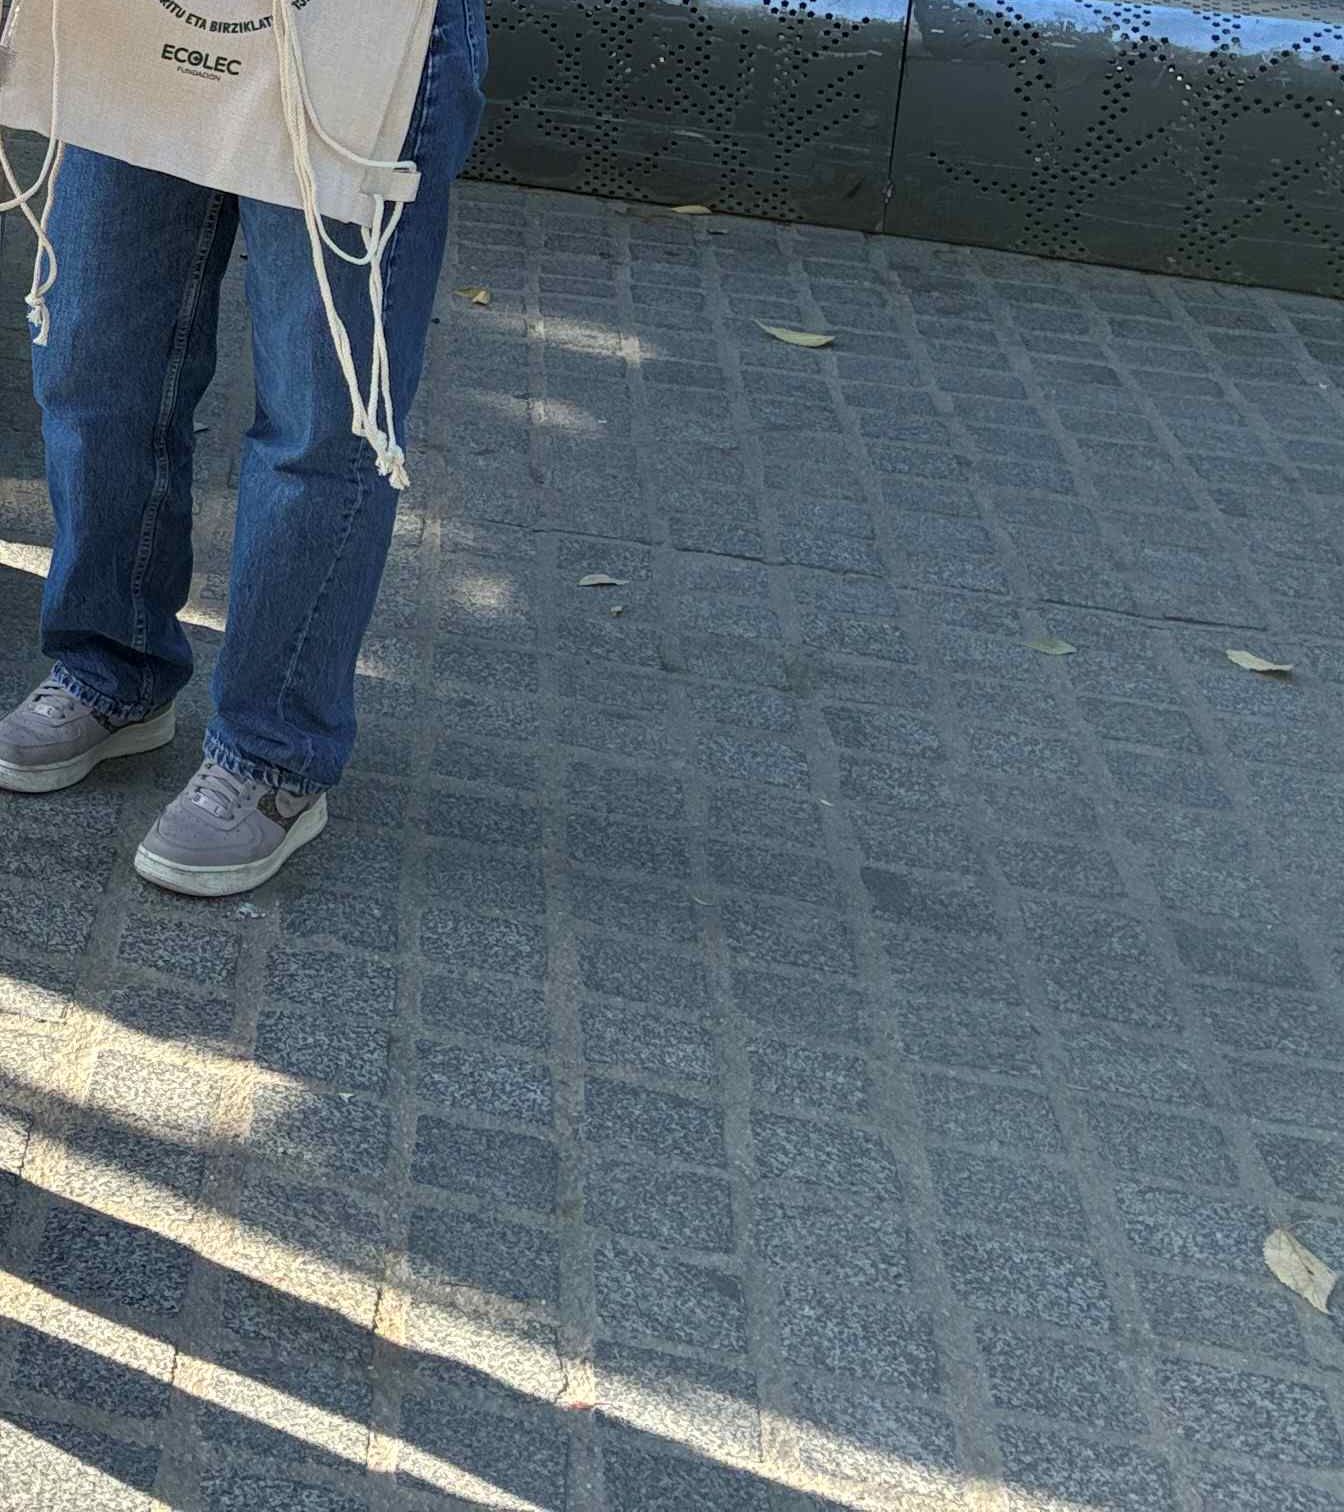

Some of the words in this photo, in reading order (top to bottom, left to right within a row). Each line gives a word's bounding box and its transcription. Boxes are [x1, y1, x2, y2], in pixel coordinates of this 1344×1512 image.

[185, 13, 207, 30] ETA
[209, 15, 273, 34] BIRZIKLAT
[161, 43, 242, 76] ECOLEC
